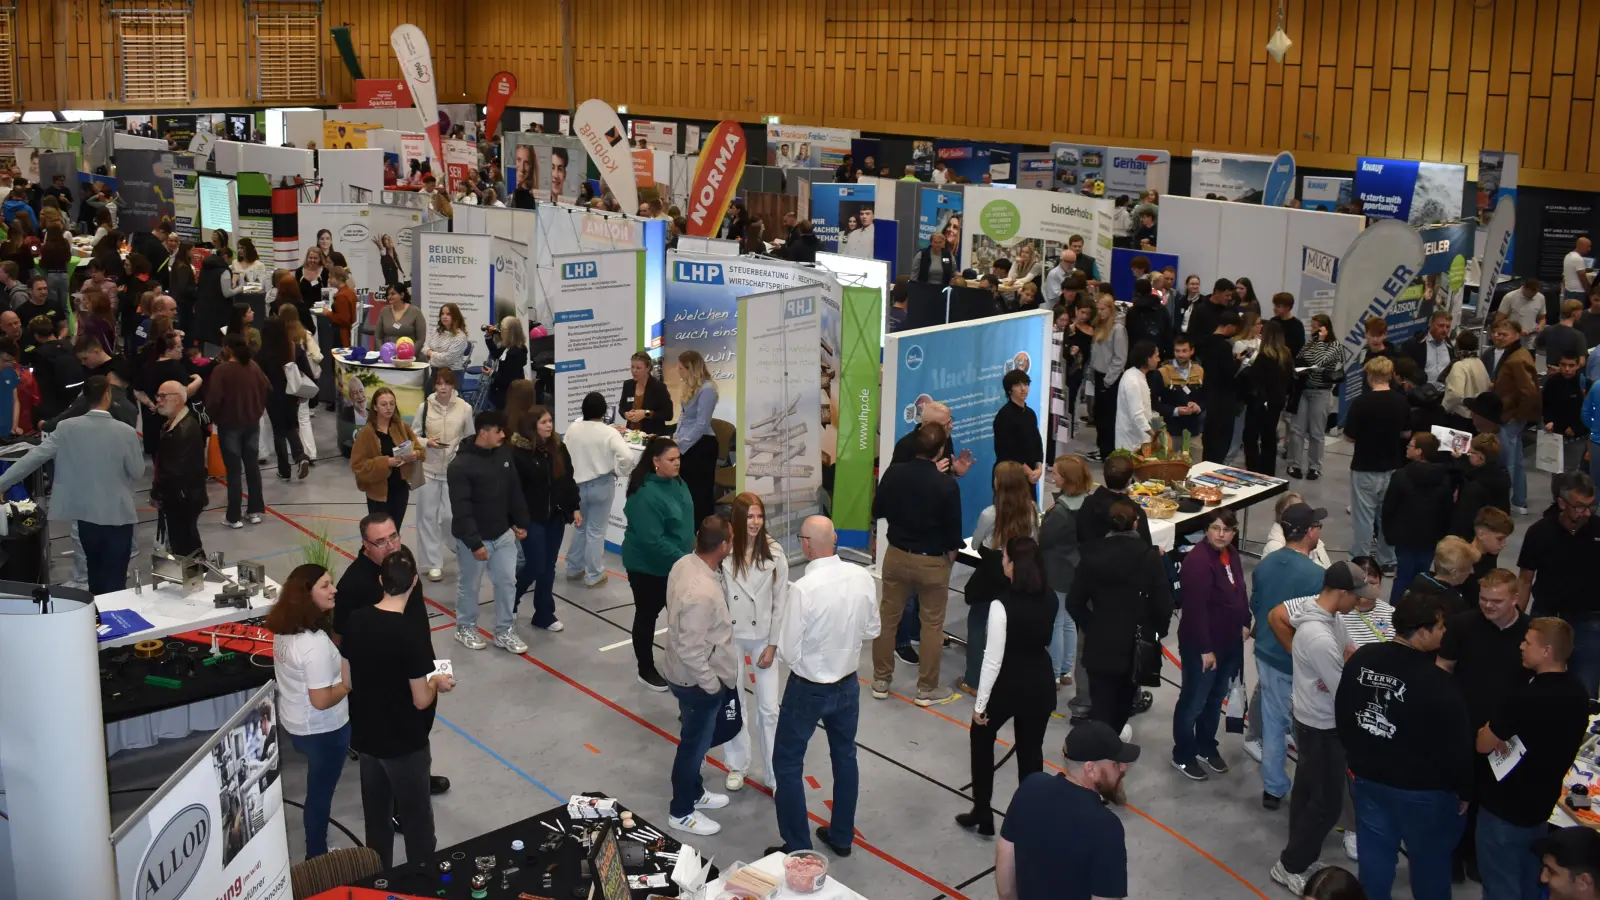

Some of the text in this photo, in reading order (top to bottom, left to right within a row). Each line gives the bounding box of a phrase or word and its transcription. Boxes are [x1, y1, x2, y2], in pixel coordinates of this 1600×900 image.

[368, 99, 397, 107] Sparkasse
[690, 132, 742, 227] NORMA
[1366, 193, 1386, 202] starts
[1386, 196, 1402, 205] with
[811, 217, 826, 225] WIR
[429, 244, 465, 256] BEI UNS
[429, 255, 479, 265] ARBEITEN:
[1307, 251, 1333, 274] MUCK
[1484, 230, 1512, 305] WEILER
[565, 262, 596, 280] LHP
[679, 262, 720, 283] LHP
[729, 265, 789, 280] STEUERBERATUNG
[674, 307, 729, 322] Welchen
[675, 327, 709, 340] auch
[703, 345, 737, 363] wir
[711, 368, 735, 381] iten
[859, 388, 872, 451] www.lhp.de
[1366, 673, 1398, 687] KERWA
[145, 818, 208, 897] ALLOD
